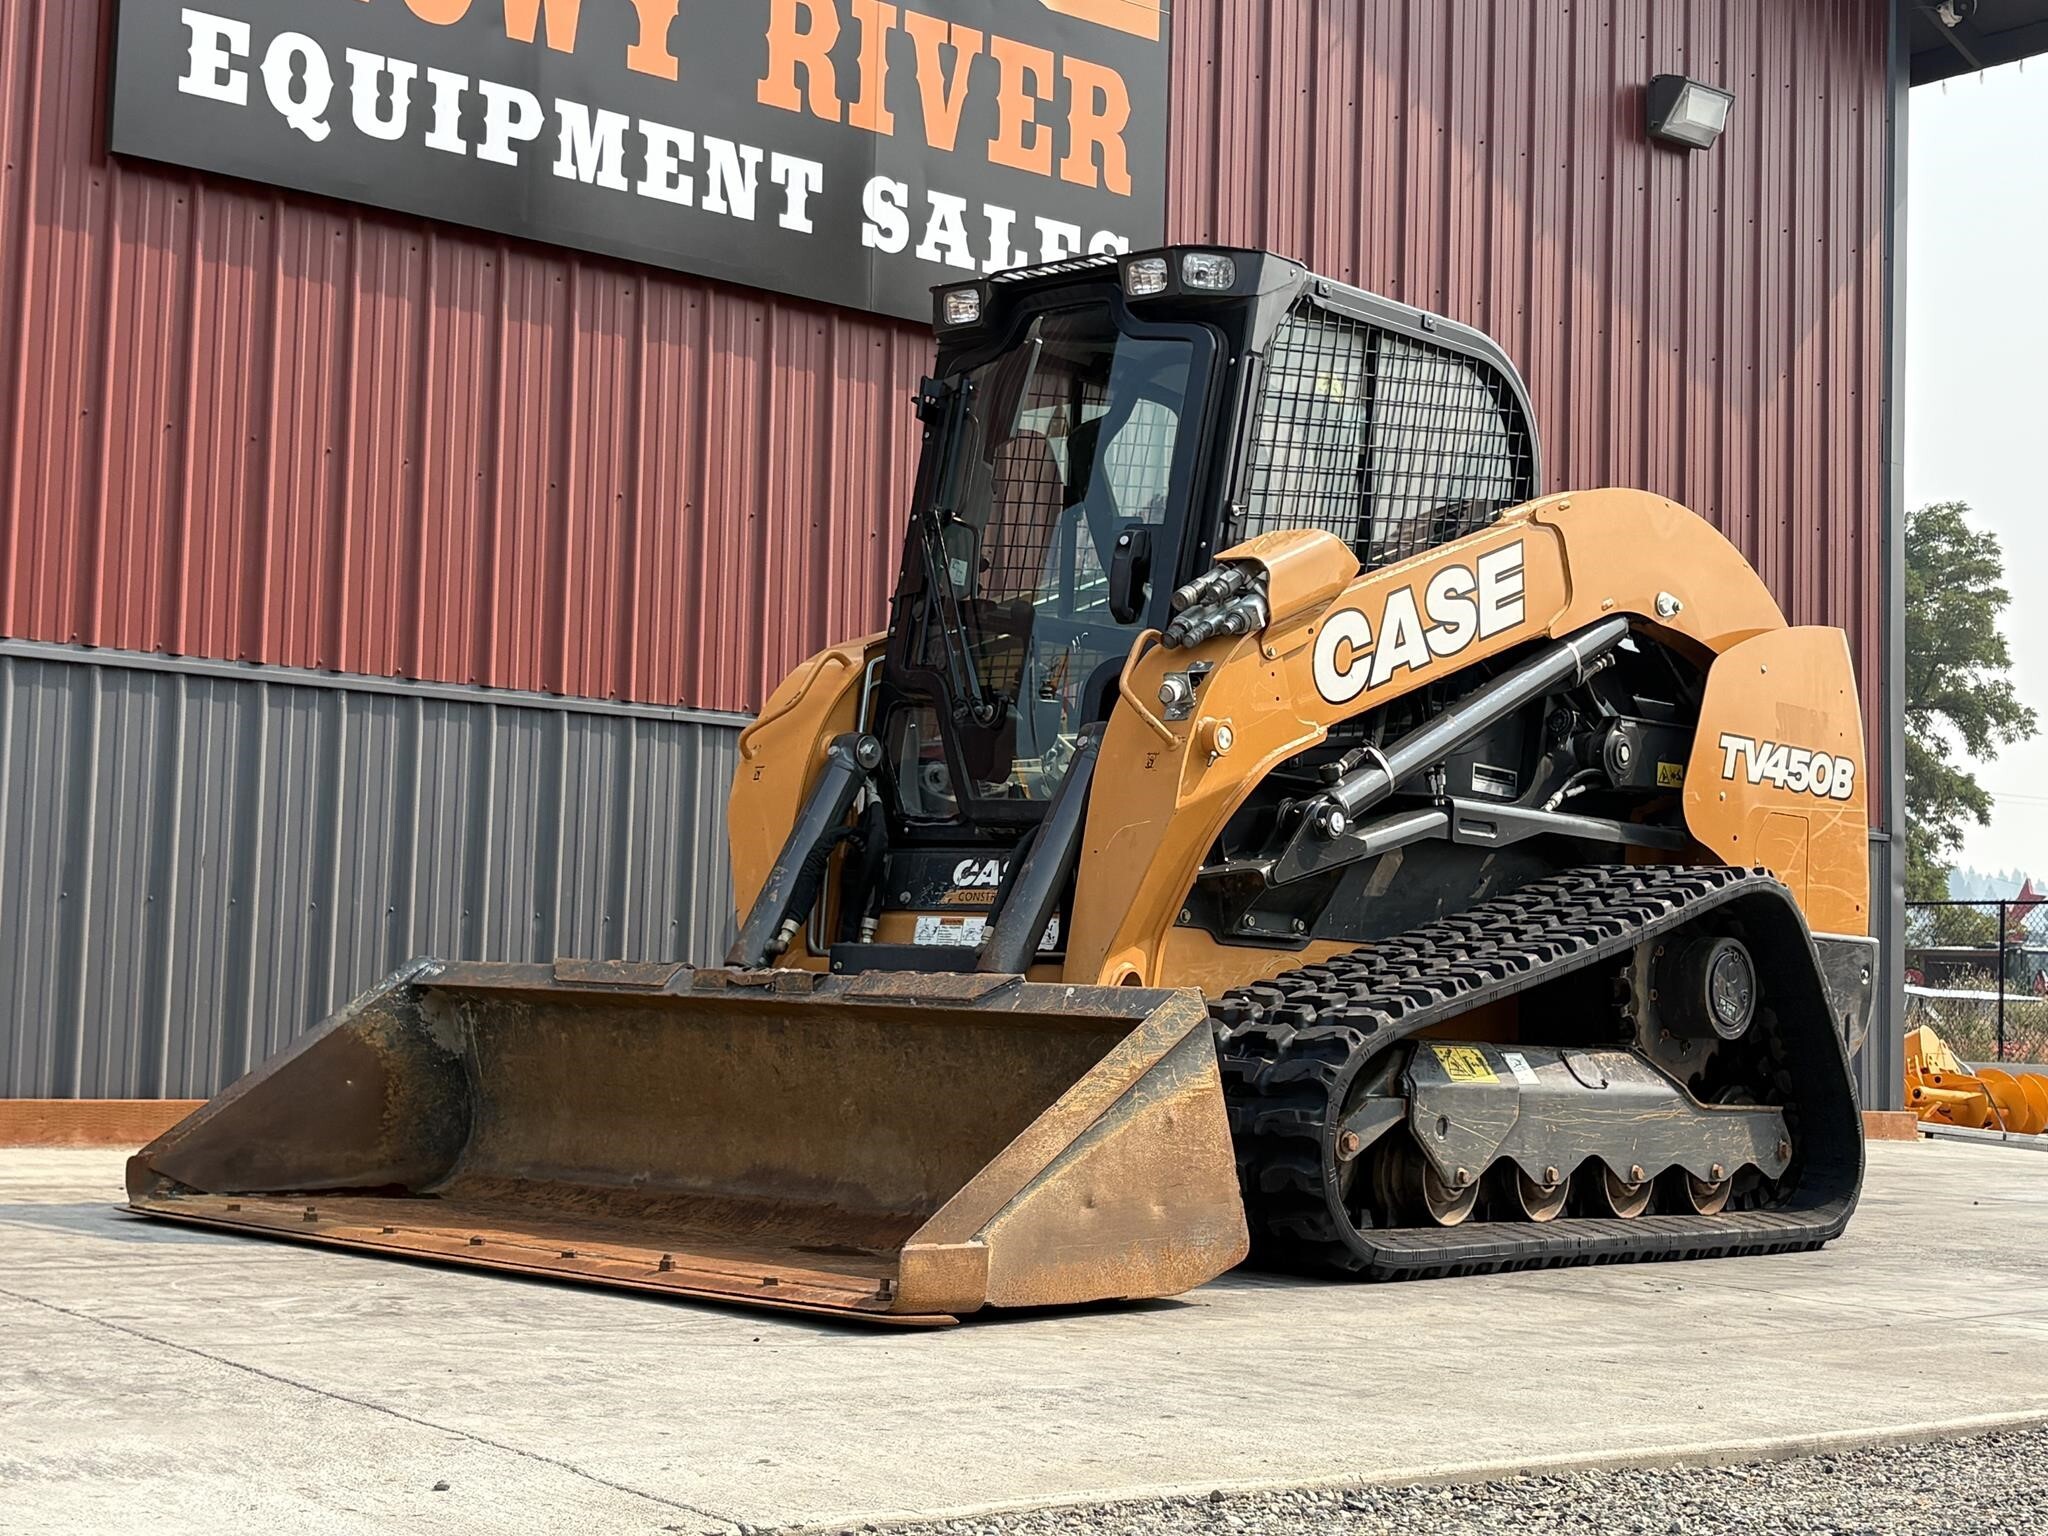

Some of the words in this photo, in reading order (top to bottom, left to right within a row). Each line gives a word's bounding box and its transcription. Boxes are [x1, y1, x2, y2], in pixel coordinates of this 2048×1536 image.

[178, 7, 824, 235] EQUIPMENT
[757, 0, 1132, 197] RIVER
[1312, 538, 1526, 706] CASE
[1718, 732, 1856, 801] TV450B
[952, 859, 1010, 887] CA
